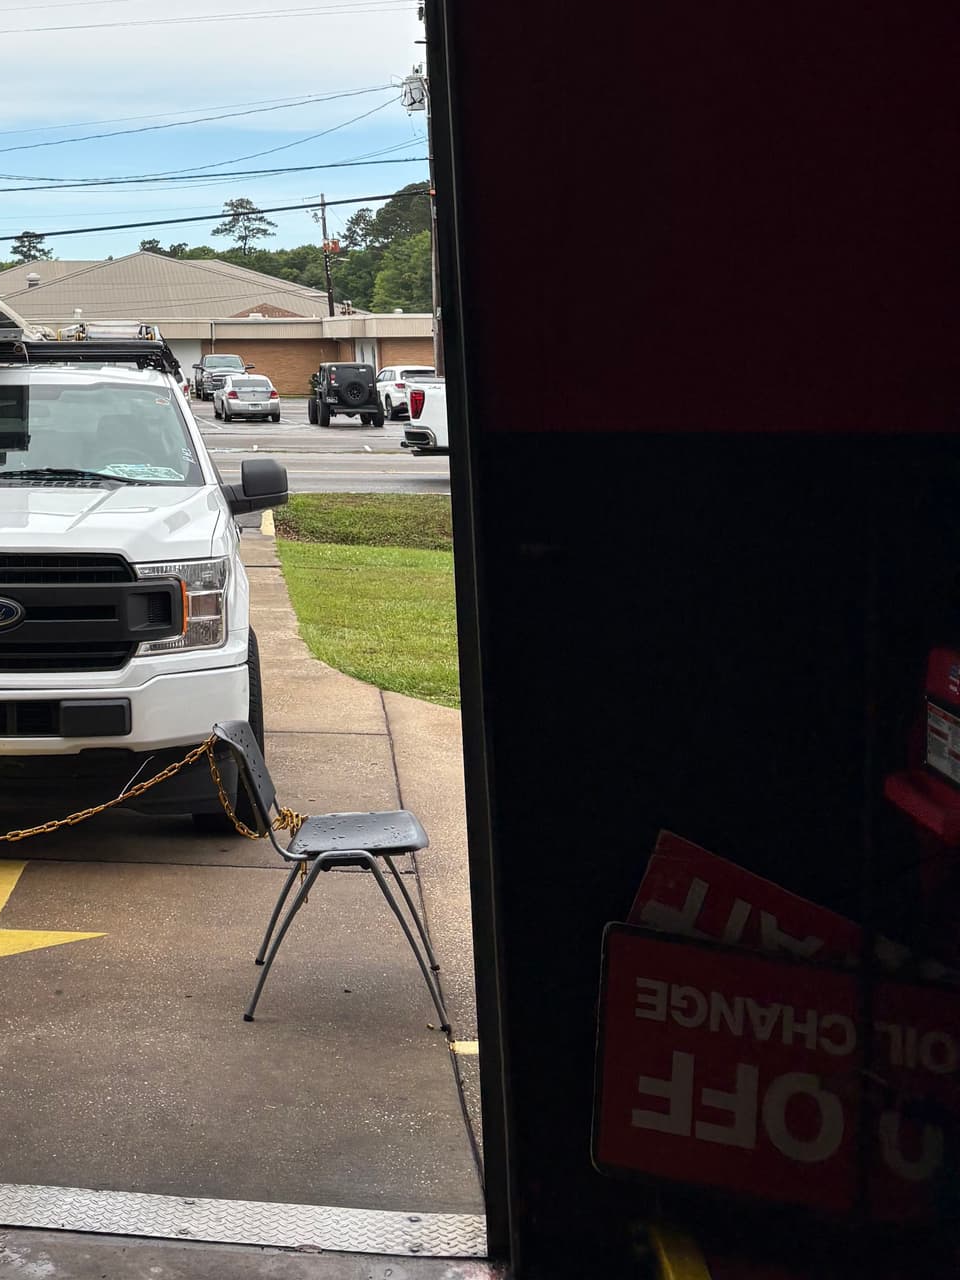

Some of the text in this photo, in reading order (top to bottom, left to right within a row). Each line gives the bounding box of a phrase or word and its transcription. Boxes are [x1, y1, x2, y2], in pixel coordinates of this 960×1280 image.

[634, 976, 958, 1075] OIL CHANGE
[631, 1049, 845, 1163] OFF
